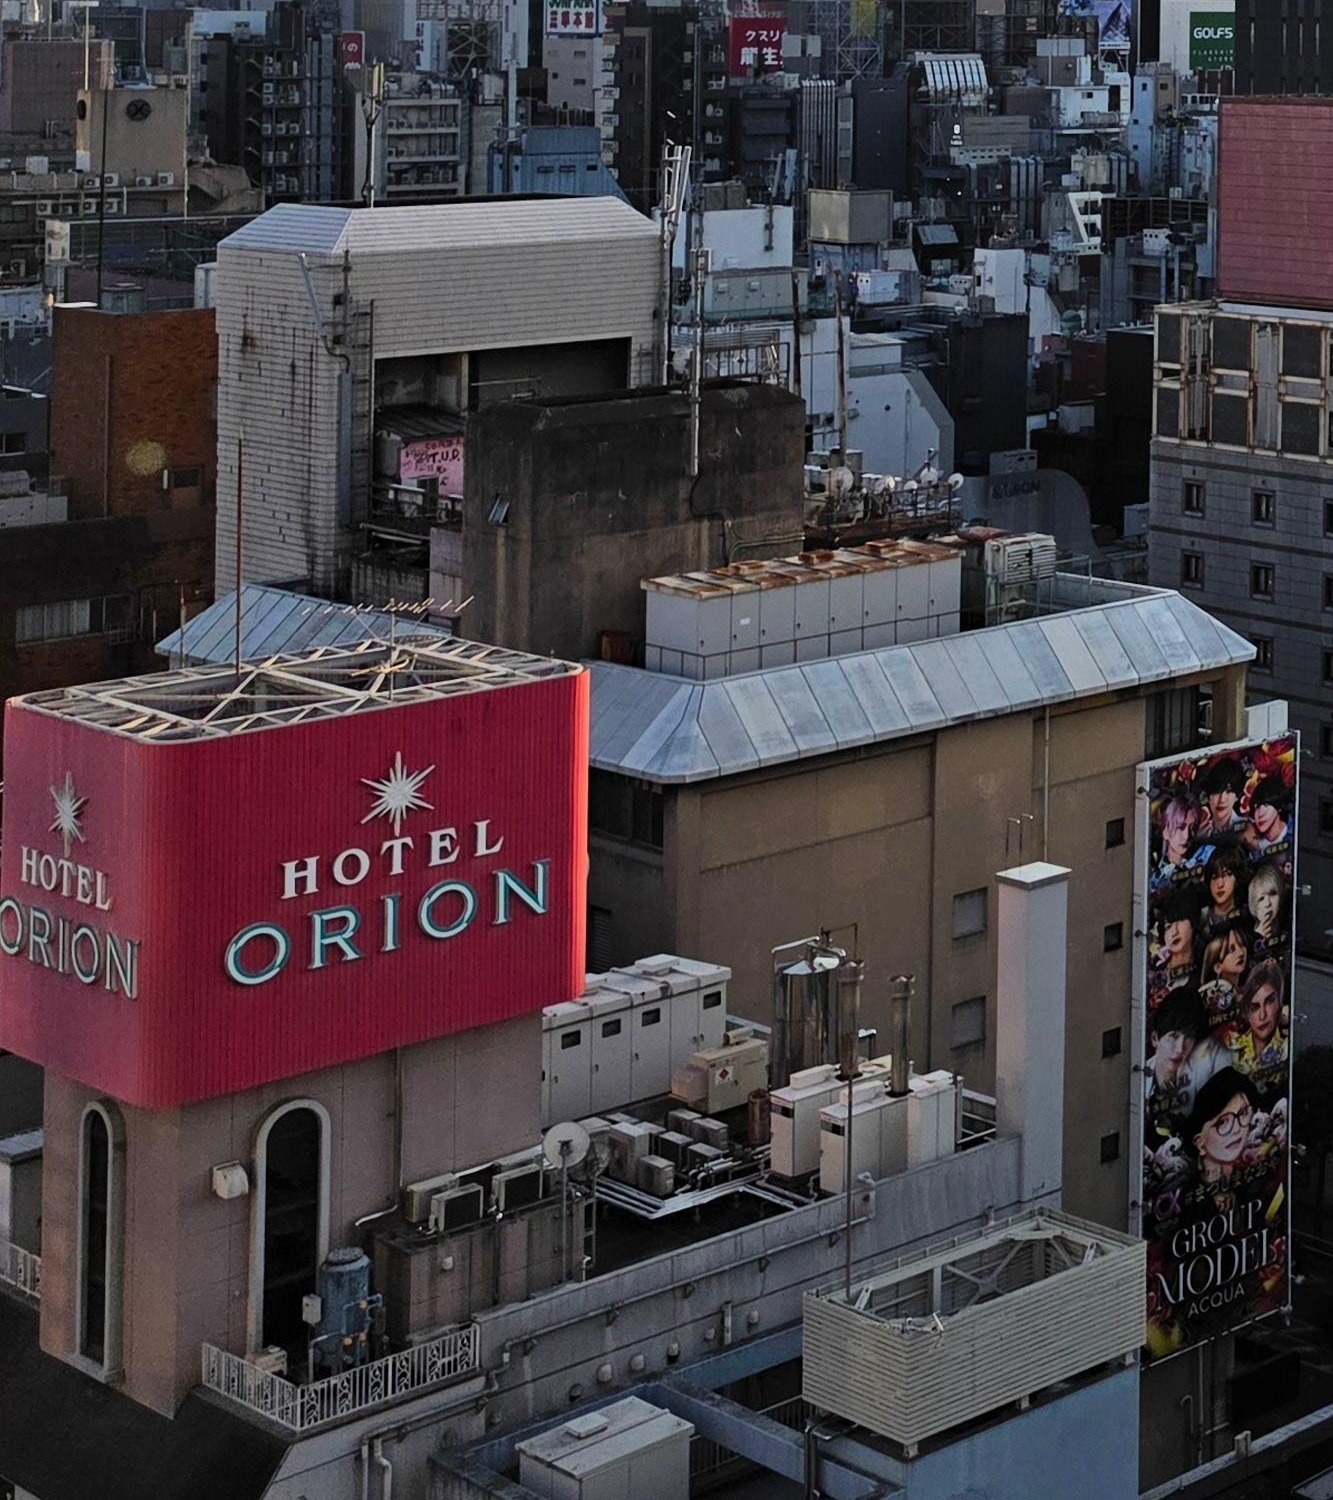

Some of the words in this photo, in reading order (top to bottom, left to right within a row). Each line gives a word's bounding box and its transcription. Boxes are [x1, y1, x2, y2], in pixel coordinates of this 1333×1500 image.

[1193, 27, 1234, 39] GOLF5
[20, 844, 112, 912] HOTEL
[280, 819, 504, 899] HOTEL
[0, 895, 141, 1000] ORION
[223, 858, 550, 986] ORION
[1172, 1199, 1262, 1258] GROUP
[1156, 1228, 1277, 1304] MODEL
[1188, 1283, 1245, 1318] ACQUA
